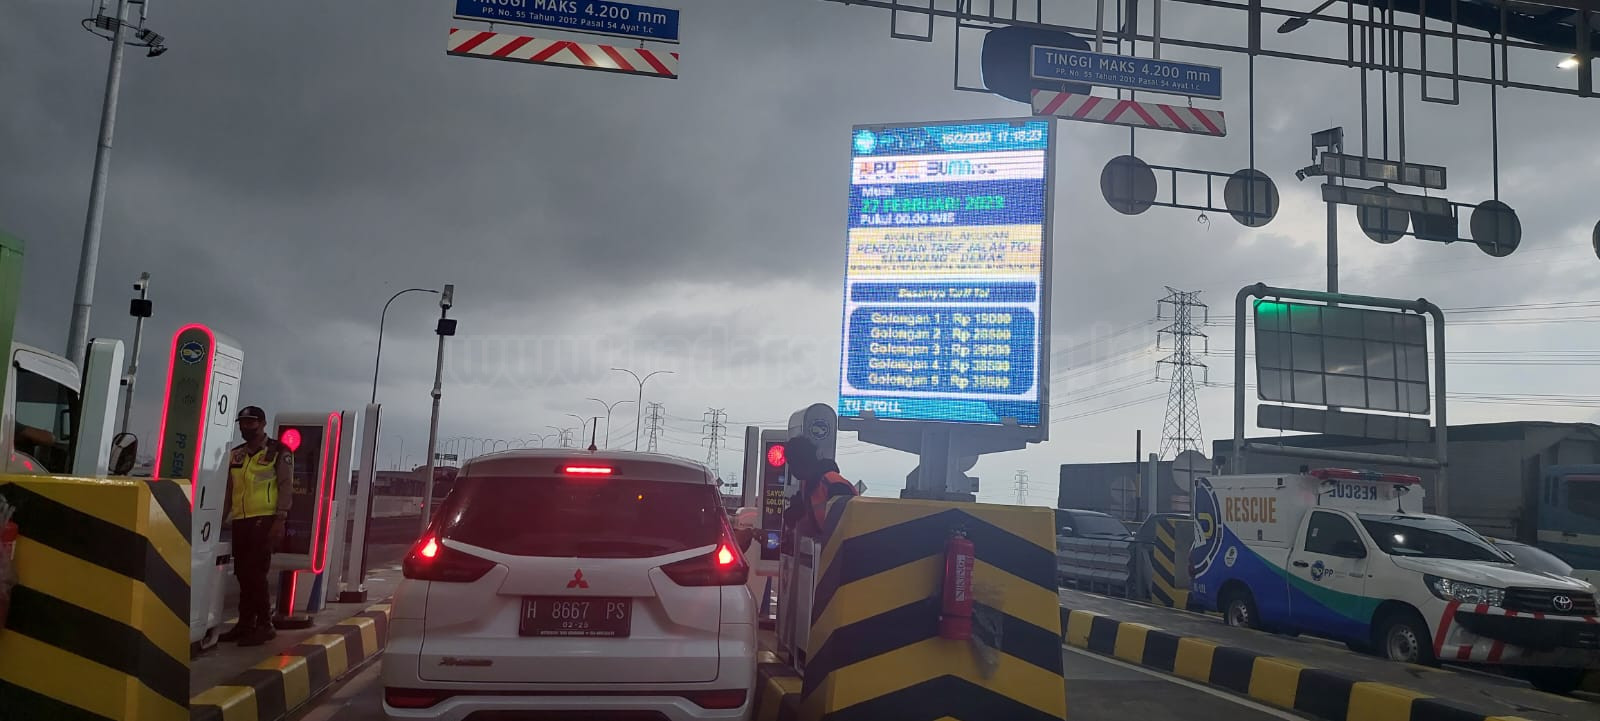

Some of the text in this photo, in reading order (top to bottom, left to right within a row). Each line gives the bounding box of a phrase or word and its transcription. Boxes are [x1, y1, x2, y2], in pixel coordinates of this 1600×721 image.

[535, 0, 577, 14] MAKS
[584, 3, 630, 20] 4.200
[637, 10, 667, 25] mm
[497, 9, 513, 17] No.
[529, 12, 555, 22] Tahun
[558, 15, 577, 25] 2012
[580, 18, 604, 28] Pasal
[607, 22, 617, 30] 54
[620, 23, 639, 33] Ayat
[1046, 52, 1210, 82] TINGGI MAKS 4.200 mm
[1095, 72, 1117, 81] Tahun
[1119, 75, 1135, 84] 2012
[1138, 77, 1158, 86] Pasal
[1171, 81, 1188, 90] Ayat
[862, 187, 895, 197] Mulai
[861, 196, 1005, 213] 27 FEBRUARI 2023
[860, 213, 892, 225] Pukul
[930, 212, 955, 223] WIB
[884, 233, 914, 242] AKAN
[857, 241, 1033, 255] PENERAPAN TARIF JALAN TOL
[881, 254, 948, 263] SEMARANG
[959, 253, 1005, 263] DEMAK
[898, 287, 990, 300] Besarnya Tarif Tol
[870, 313, 929, 326] Golongan
[934, 313, 940, 323] 1
[952, 313, 972, 327] Rp
[870, 328, 930, 341] Golongan
[933, 328, 940, 339] 2
[952, 328, 972, 342] Rp
[869, 343, 928, 356] Golongan
[933, 343, 940, 355] 3
[951, 344, 970, 358] Rp
[869, 357, 928, 371] Golongan
[931, 359, 938, 369] 4
[950, 359, 969, 373] Rp
[868, 373, 927, 387] Golongan
[931, 375, 938, 386] 5
[949, 375, 968, 389] Rp
[1225, 496, 1278, 524] RESCUE
[527, 600, 625, 620] H 8667 PS
